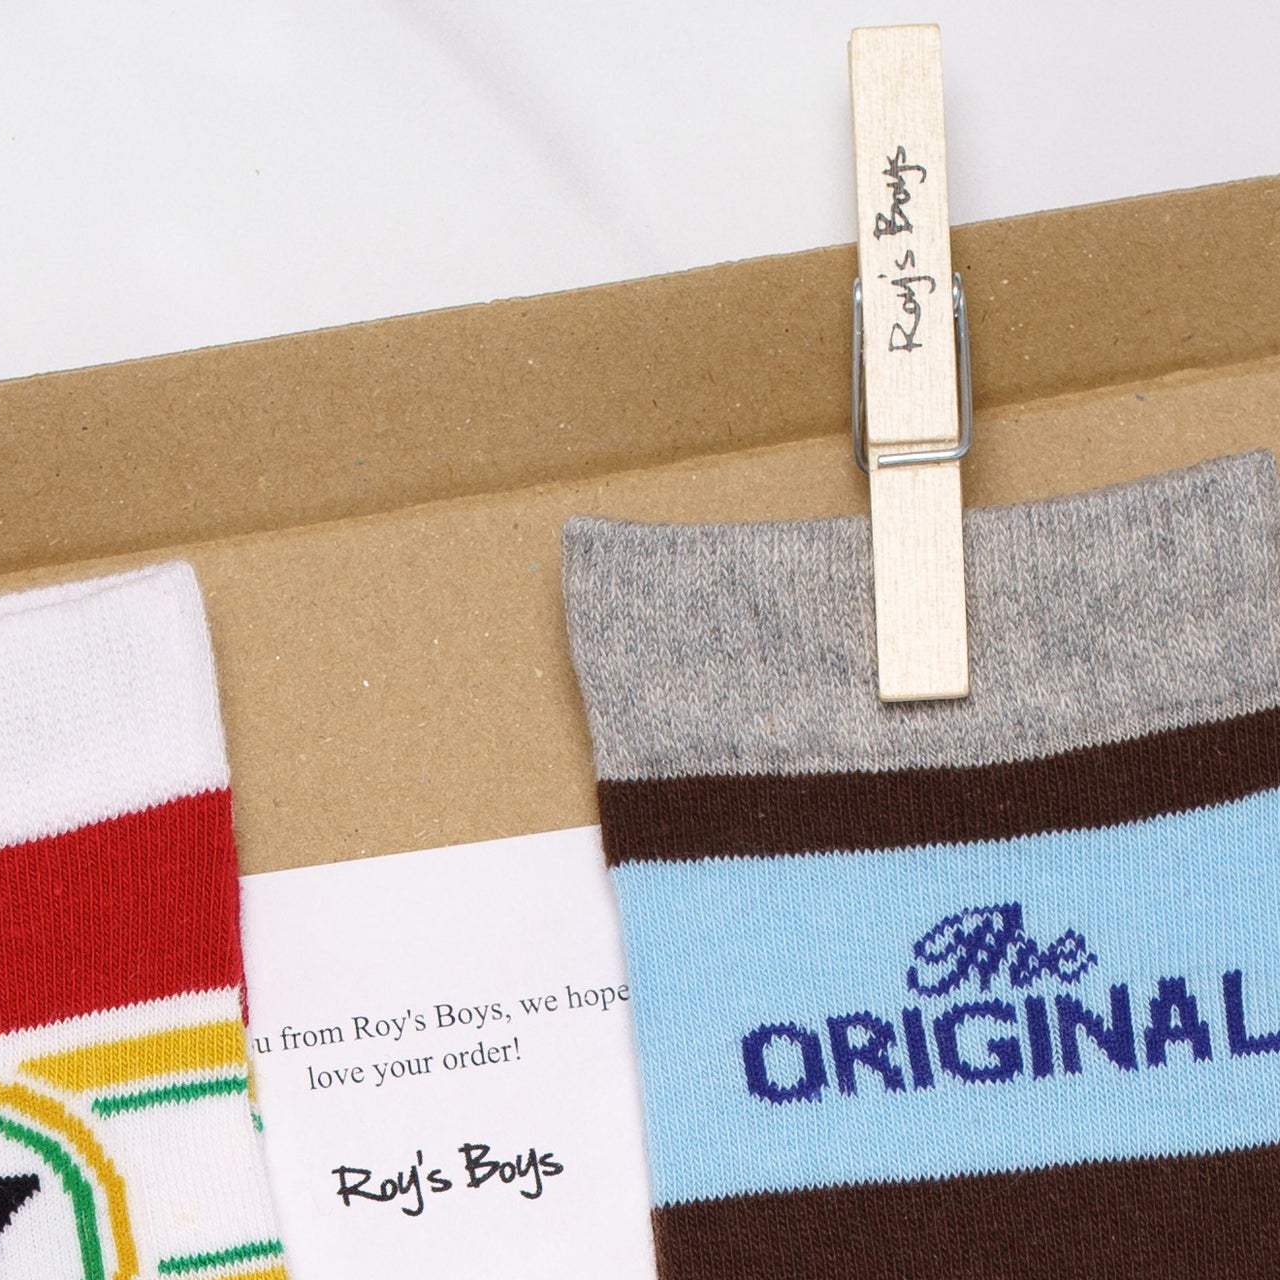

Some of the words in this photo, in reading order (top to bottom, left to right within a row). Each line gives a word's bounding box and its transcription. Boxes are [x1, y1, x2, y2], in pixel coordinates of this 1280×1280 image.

[873, 145, 927, 240] Boys
[878, 249, 936, 352] Roy's
[280, 1026, 344, 1051] from
[351, 1009, 426, 1041] Roy's
[433, 1003, 512, 1030] Boys,
[519, 995, 558, 1014] we
[565, 984, 631, 1011] hope
[307, 1066, 365, 1090] love
[372, 1056, 434, 1087] your
[442, 1036, 522, 1070] order!
[331, 1150, 453, 1217] Roy's
[458, 1143, 565, 1200] Boys
